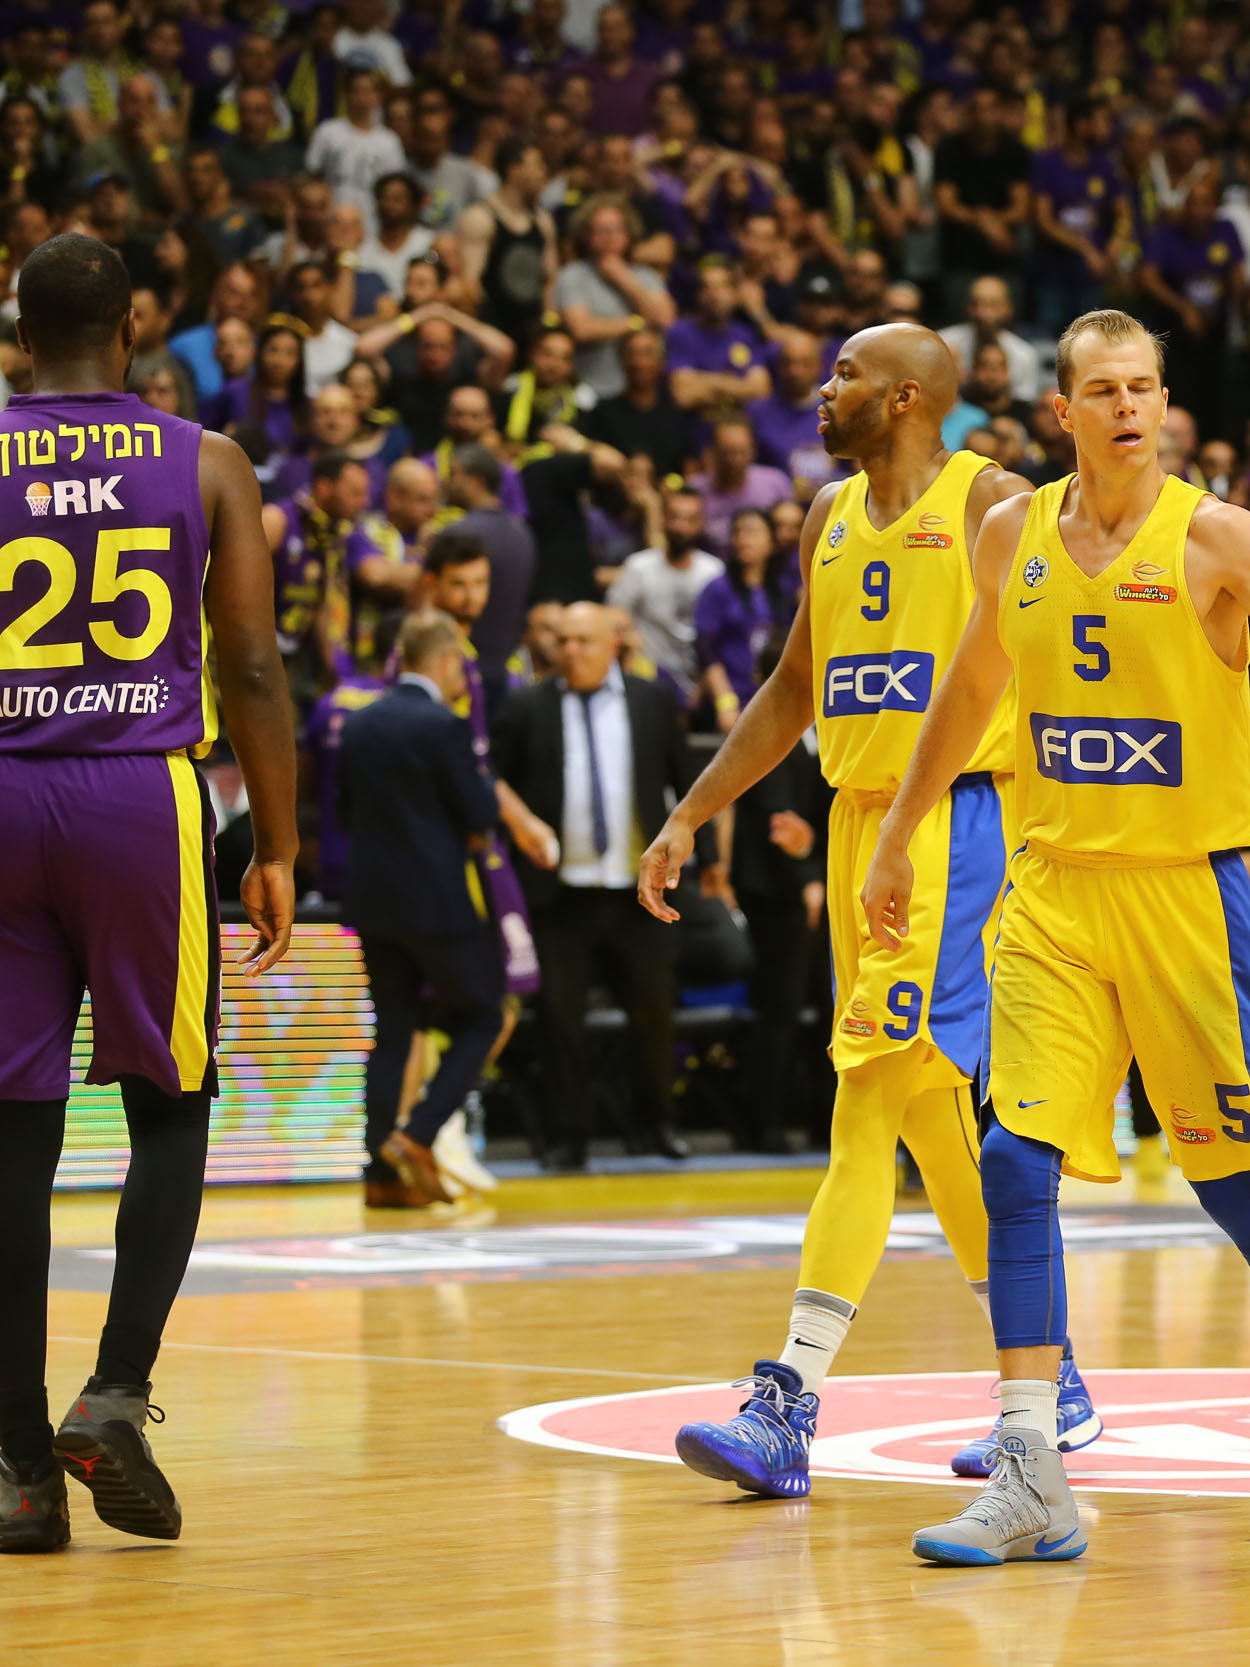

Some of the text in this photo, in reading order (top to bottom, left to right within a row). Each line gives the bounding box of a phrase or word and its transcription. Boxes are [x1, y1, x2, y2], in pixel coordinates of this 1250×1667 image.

[0, 422, 163, 477] המילטון
[0, 527, 173, 670] 25
[861, 561, 890, 621] 9
[1119, 587, 1158, 600] Winner
[1073, 615, 1111, 681] 5
[0, 682, 159, 718] UTO CENTER
[829, 663, 920, 707] FOX
[1041, 728, 1168, 775] FOX
[883, 981, 923, 1040] 9
